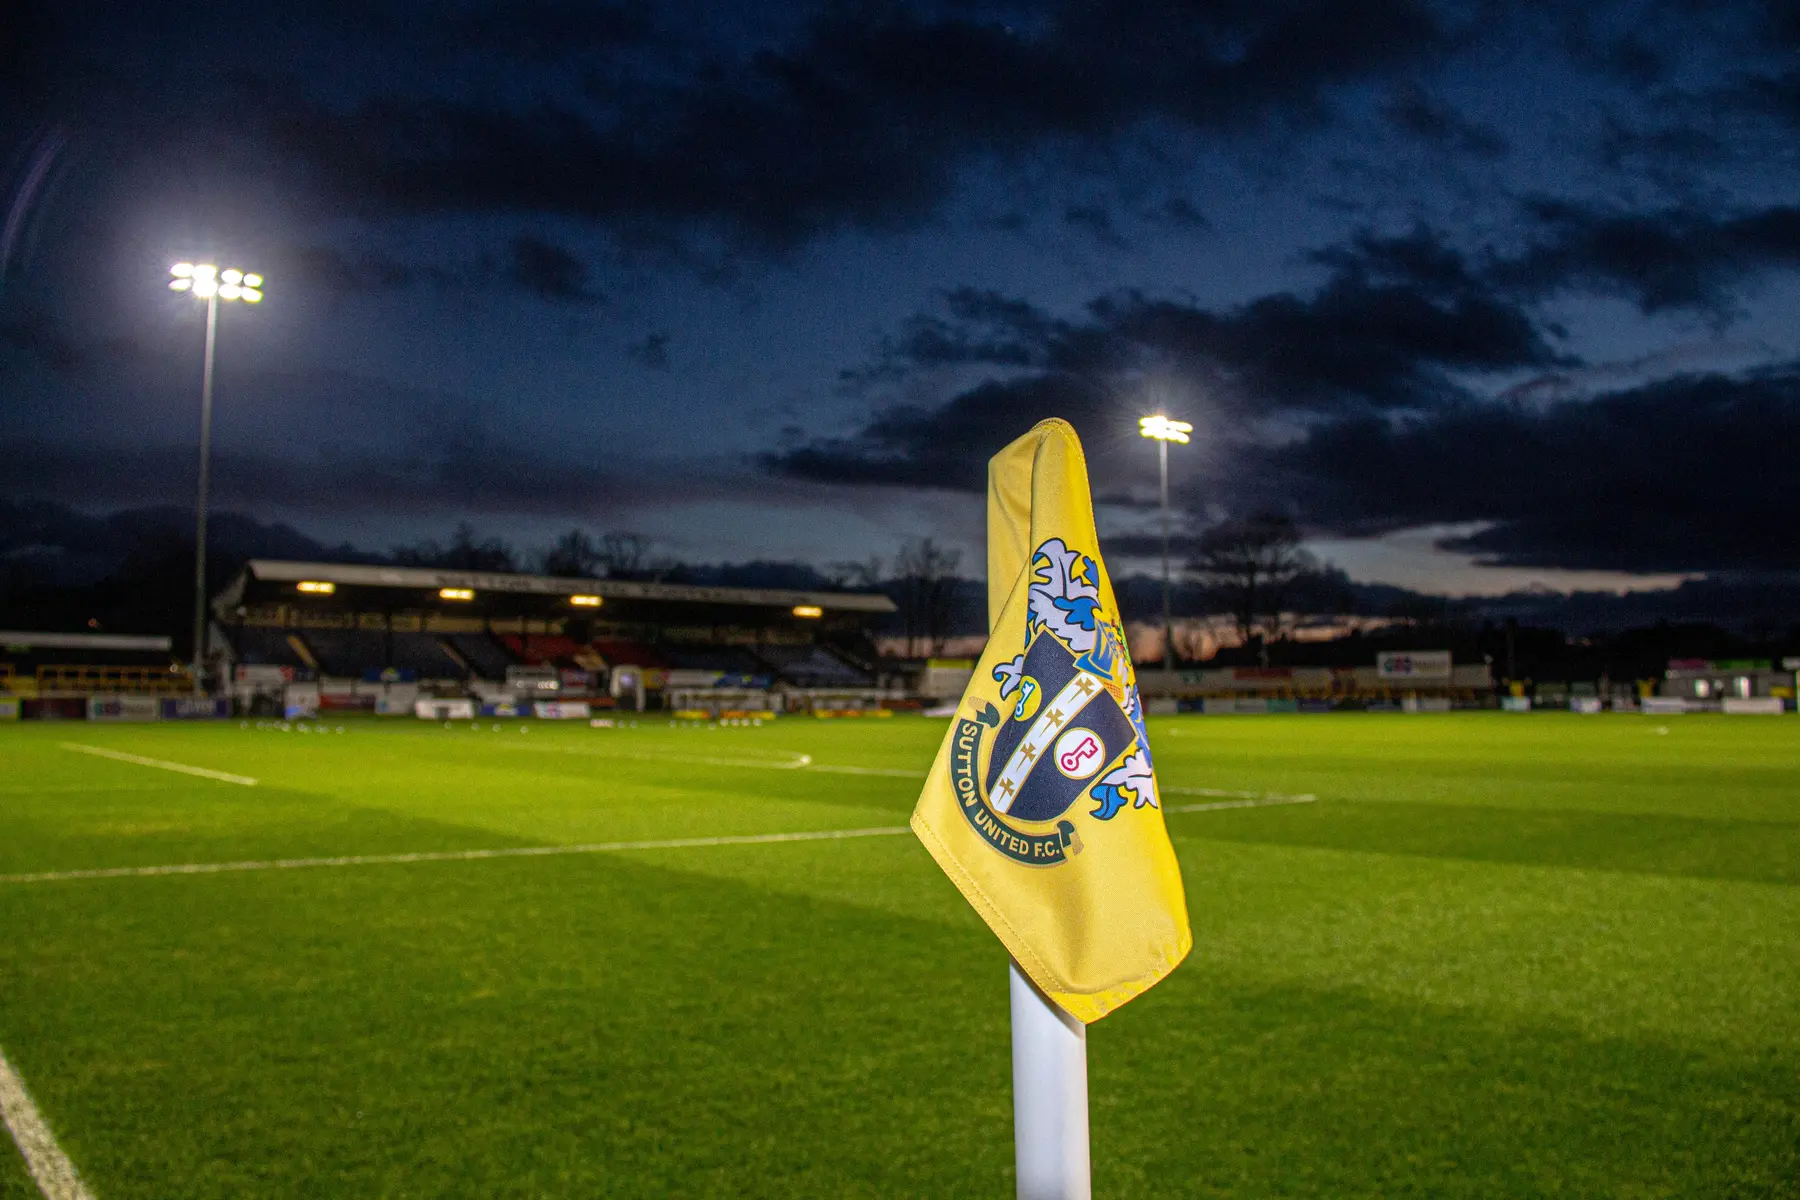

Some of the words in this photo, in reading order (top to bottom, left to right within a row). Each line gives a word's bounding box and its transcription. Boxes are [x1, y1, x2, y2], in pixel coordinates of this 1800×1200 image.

[957, 723, 978, 807] SUTTON
[974, 809, 1029, 855] UNITED
[1034, 841, 1060, 857] F.C.
